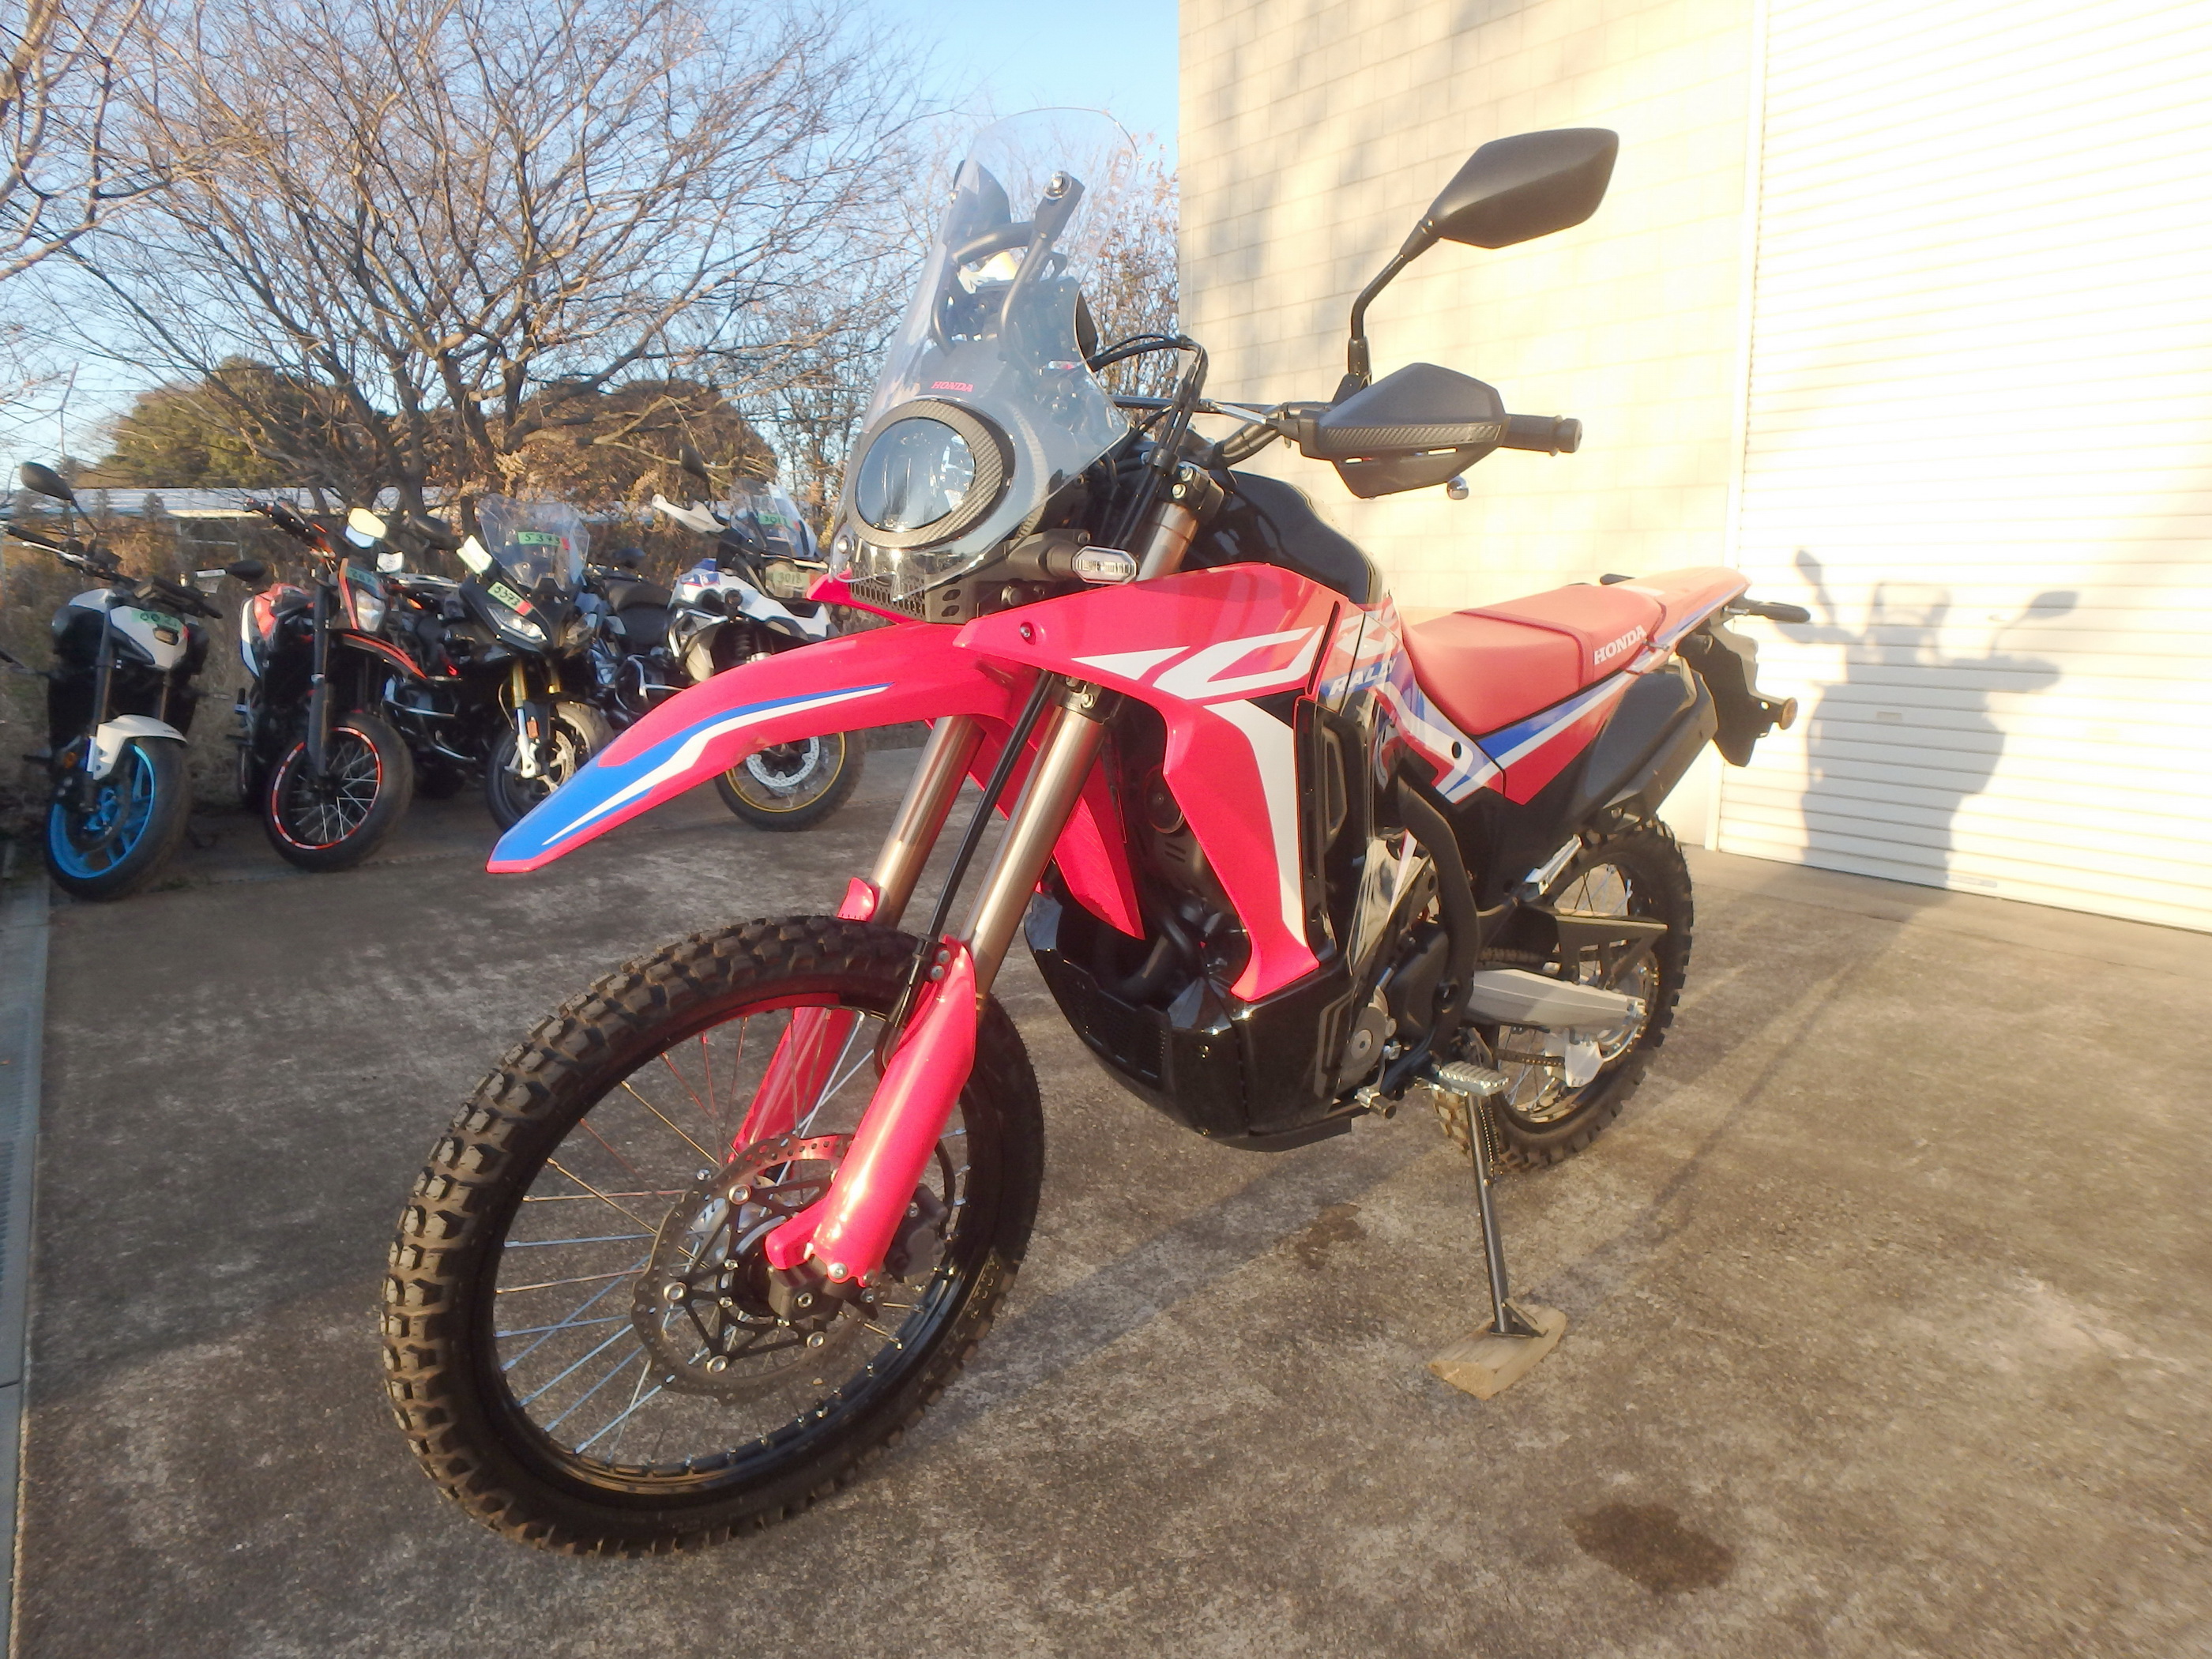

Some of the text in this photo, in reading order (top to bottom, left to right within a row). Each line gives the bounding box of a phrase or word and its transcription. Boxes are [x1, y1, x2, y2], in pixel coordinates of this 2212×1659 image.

[931, 381, 973, 393] HONDA
[494, 585, 521, 606] 5373
[1593, 624, 1647, 666] HONDA
